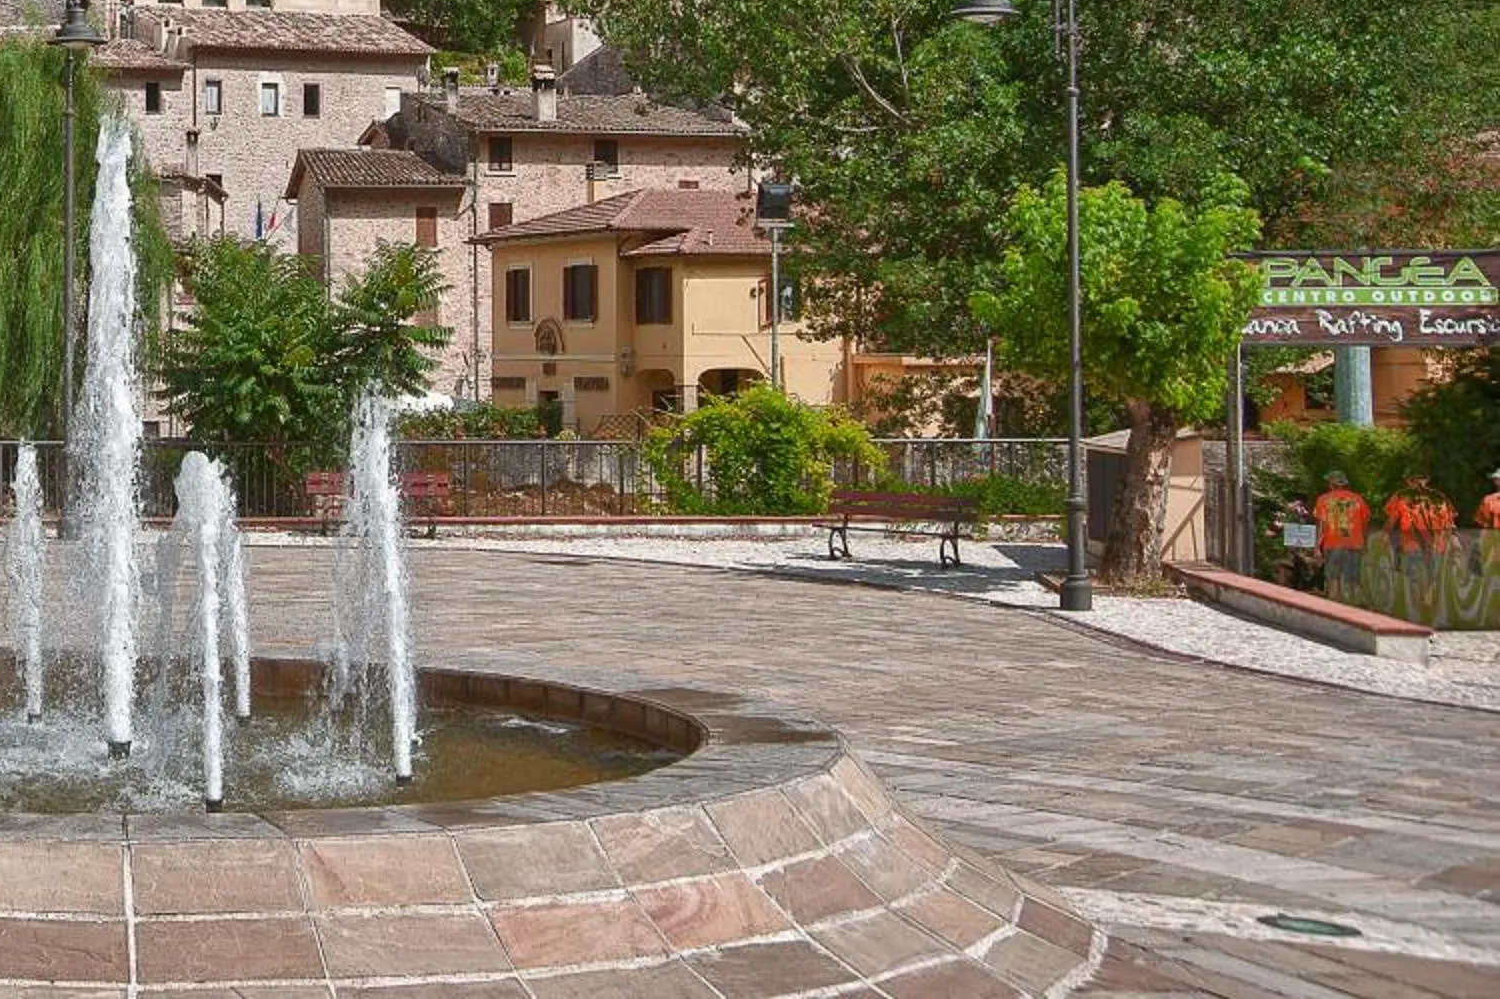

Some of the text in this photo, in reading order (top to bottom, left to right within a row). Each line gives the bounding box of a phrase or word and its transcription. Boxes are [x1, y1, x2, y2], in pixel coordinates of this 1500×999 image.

[1263, 291, 1493, 303] CENTRO OUTDOOR
[1242, 319, 1300, 335] anoa
[1316, 308, 1403, 342] Rafting
